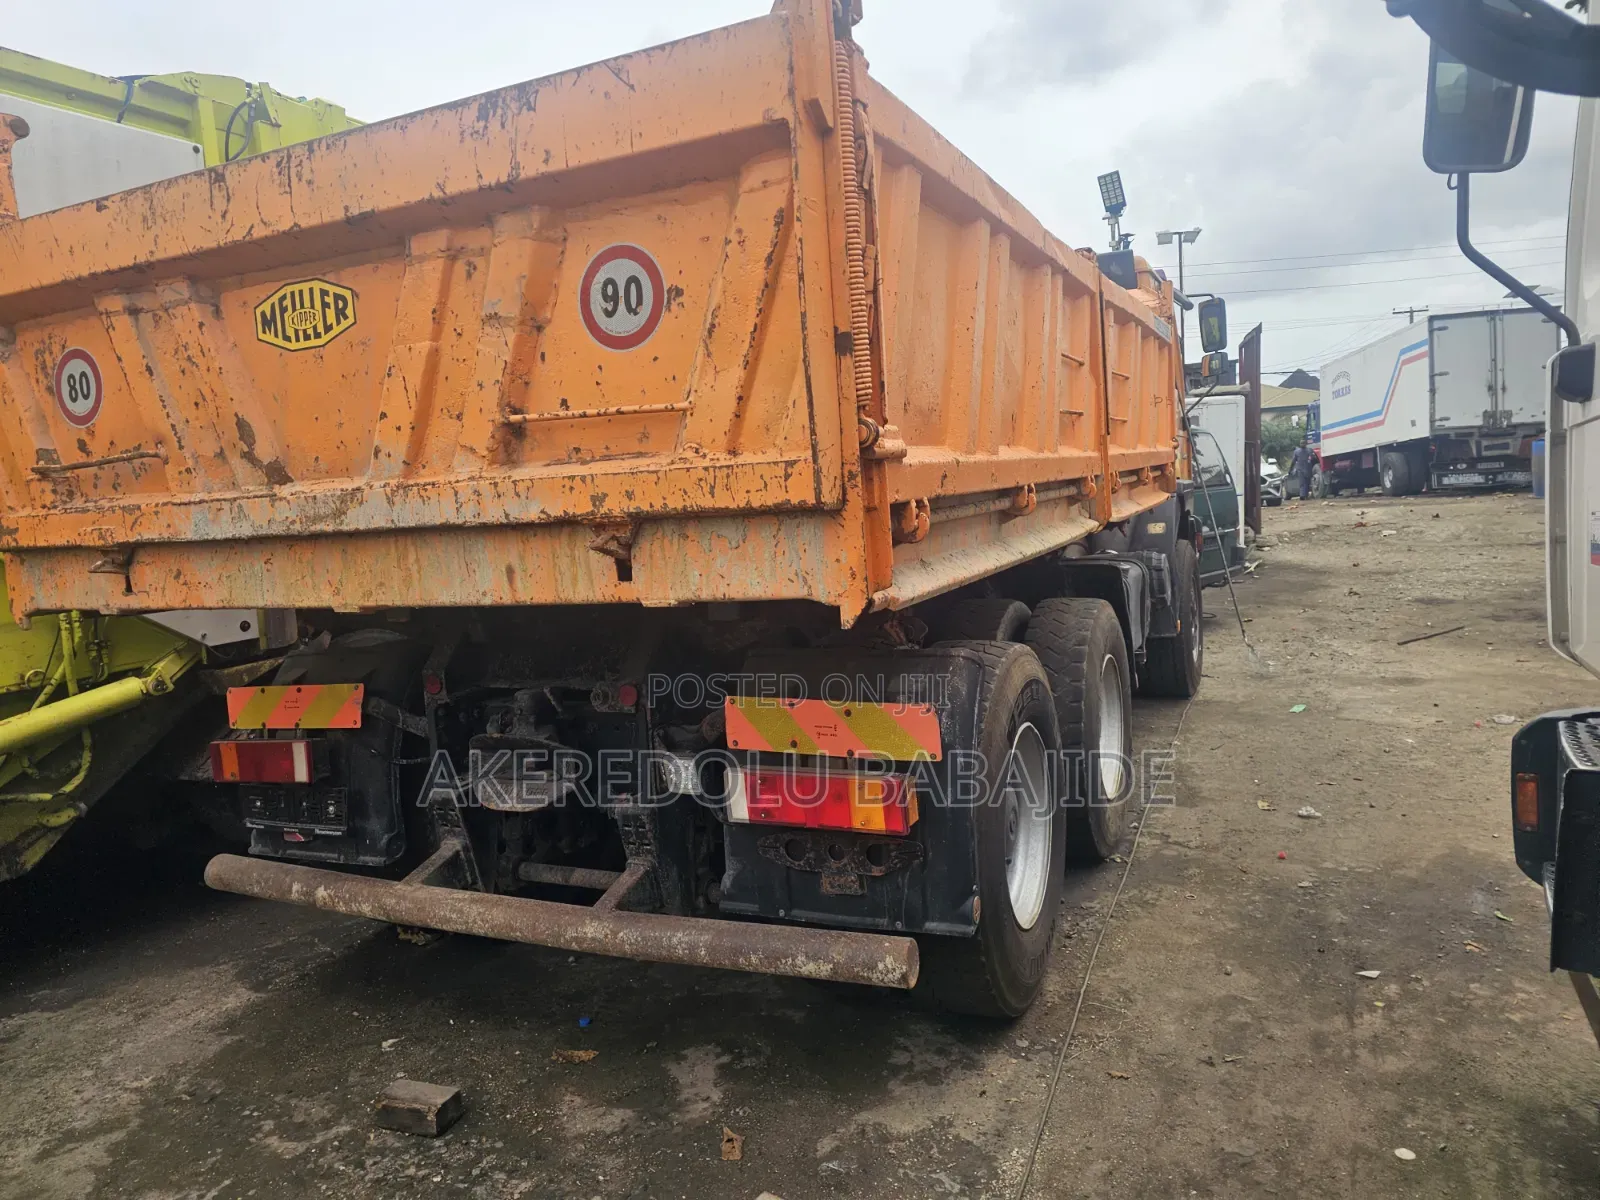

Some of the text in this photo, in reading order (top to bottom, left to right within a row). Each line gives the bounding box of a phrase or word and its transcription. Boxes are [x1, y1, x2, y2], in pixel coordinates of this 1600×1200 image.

[260, 287, 349, 343] MEILLER
[601, 274, 643, 319] 90
[291, 311, 317, 327] KIPPER
[67, 370, 91, 403] 80
